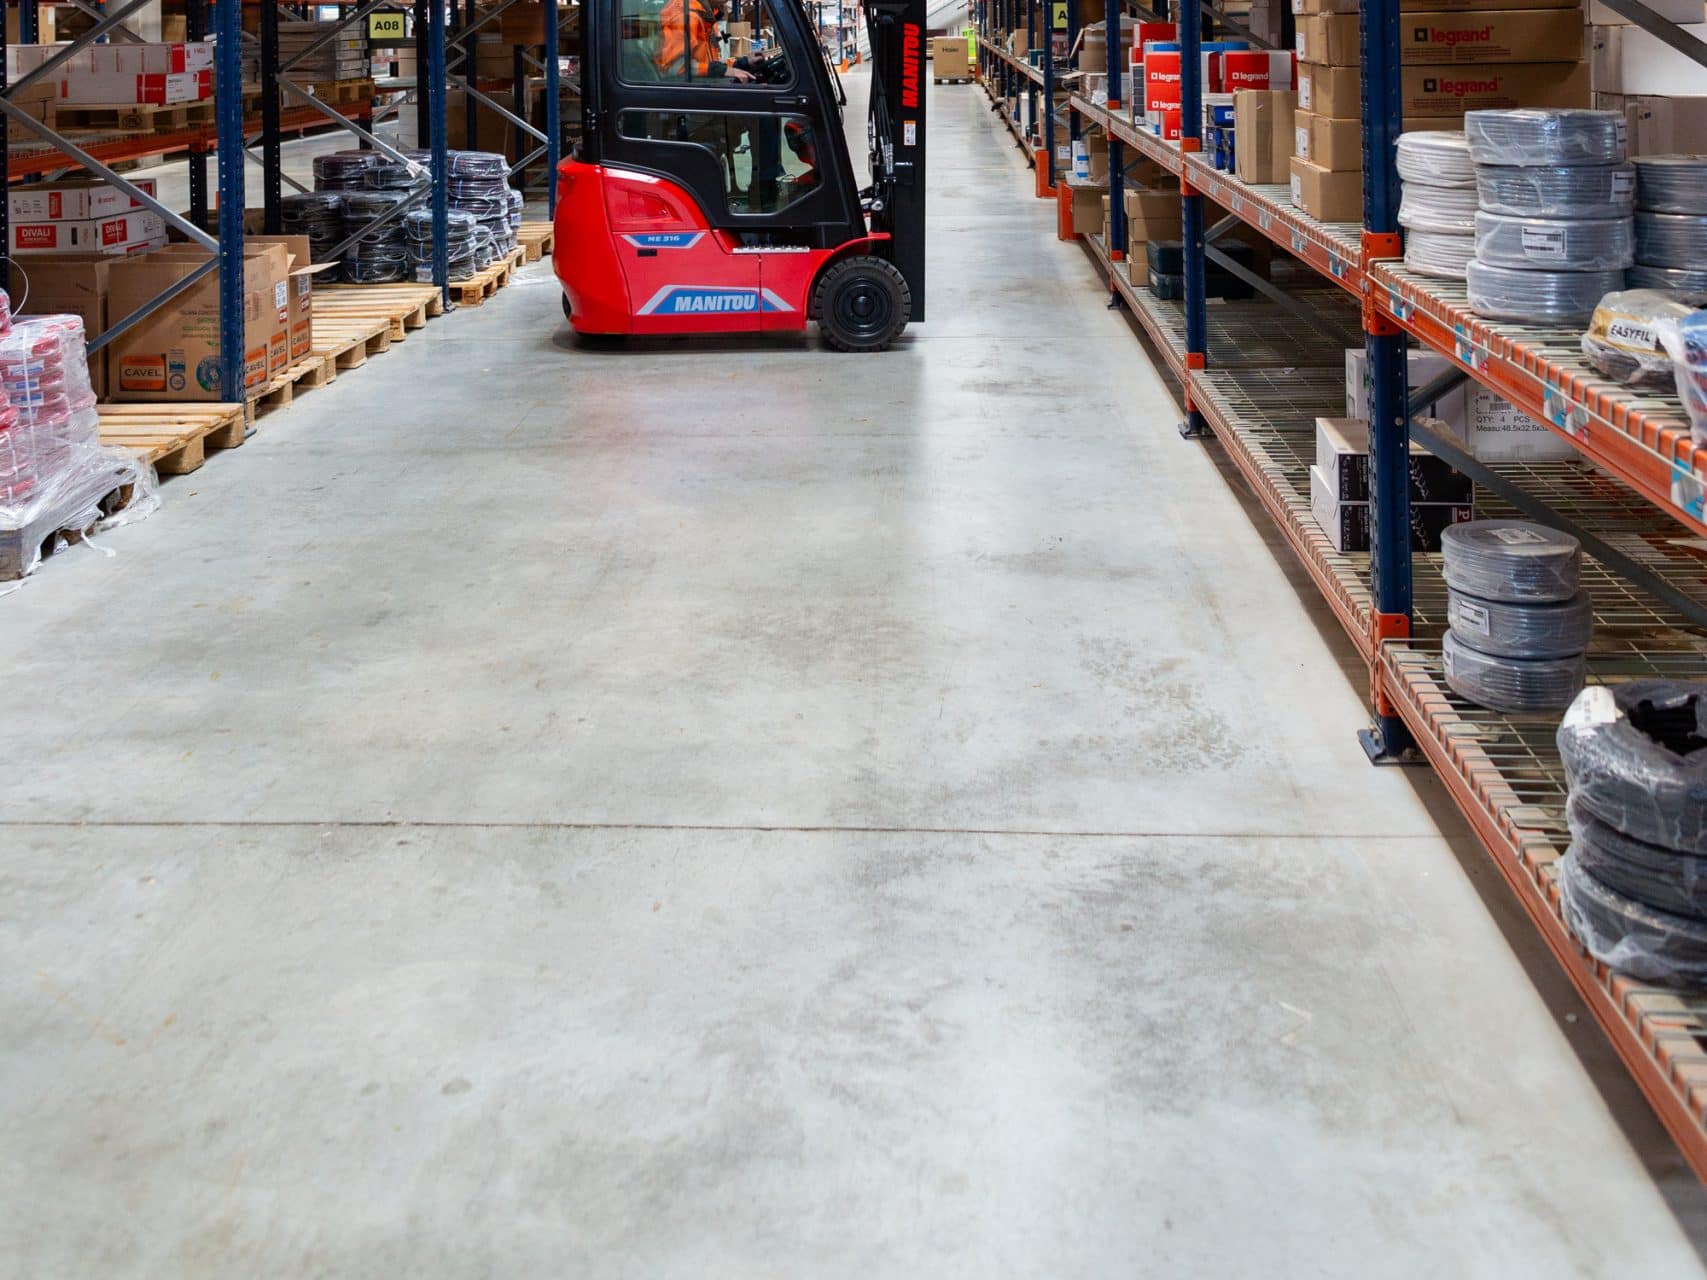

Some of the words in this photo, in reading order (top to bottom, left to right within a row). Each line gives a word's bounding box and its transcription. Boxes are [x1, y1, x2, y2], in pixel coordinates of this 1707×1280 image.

[374, 20, 399, 31] A08
[1431, 26, 1490, 46] legrand
[902, 23, 920, 108] MANITOU
[1240, 71, 1269, 81] legrand
[1439, 77, 1498, 96] legrand
[22, 228, 50, 237] DIVALI
[674, 294, 756, 312] MANITOU
[1610, 324, 1650, 342] EASYFIL
[124, 367, 162, 377] CAVEL
[1513, 415, 1530, 423] PCS
